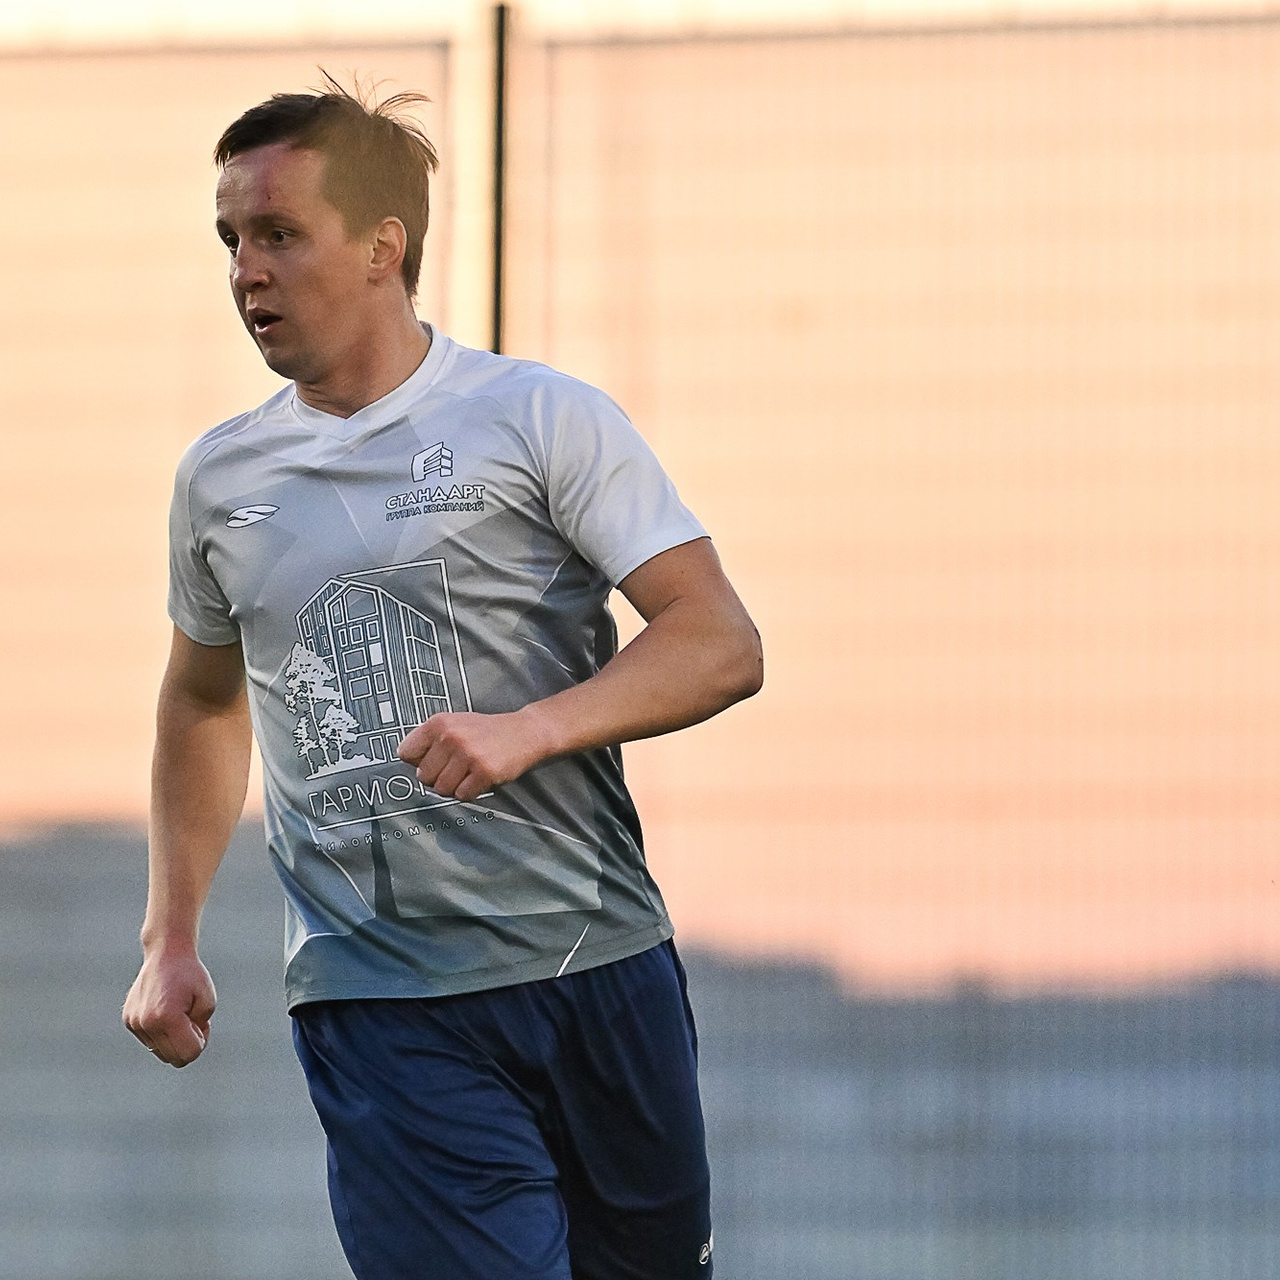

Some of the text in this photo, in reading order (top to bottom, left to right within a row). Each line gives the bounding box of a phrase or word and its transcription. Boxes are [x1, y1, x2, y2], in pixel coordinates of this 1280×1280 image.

[385, 484, 485, 509] СТАНДАРТ
[385, 500, 484, 521] ГРУППА КОМПАНИЙ
